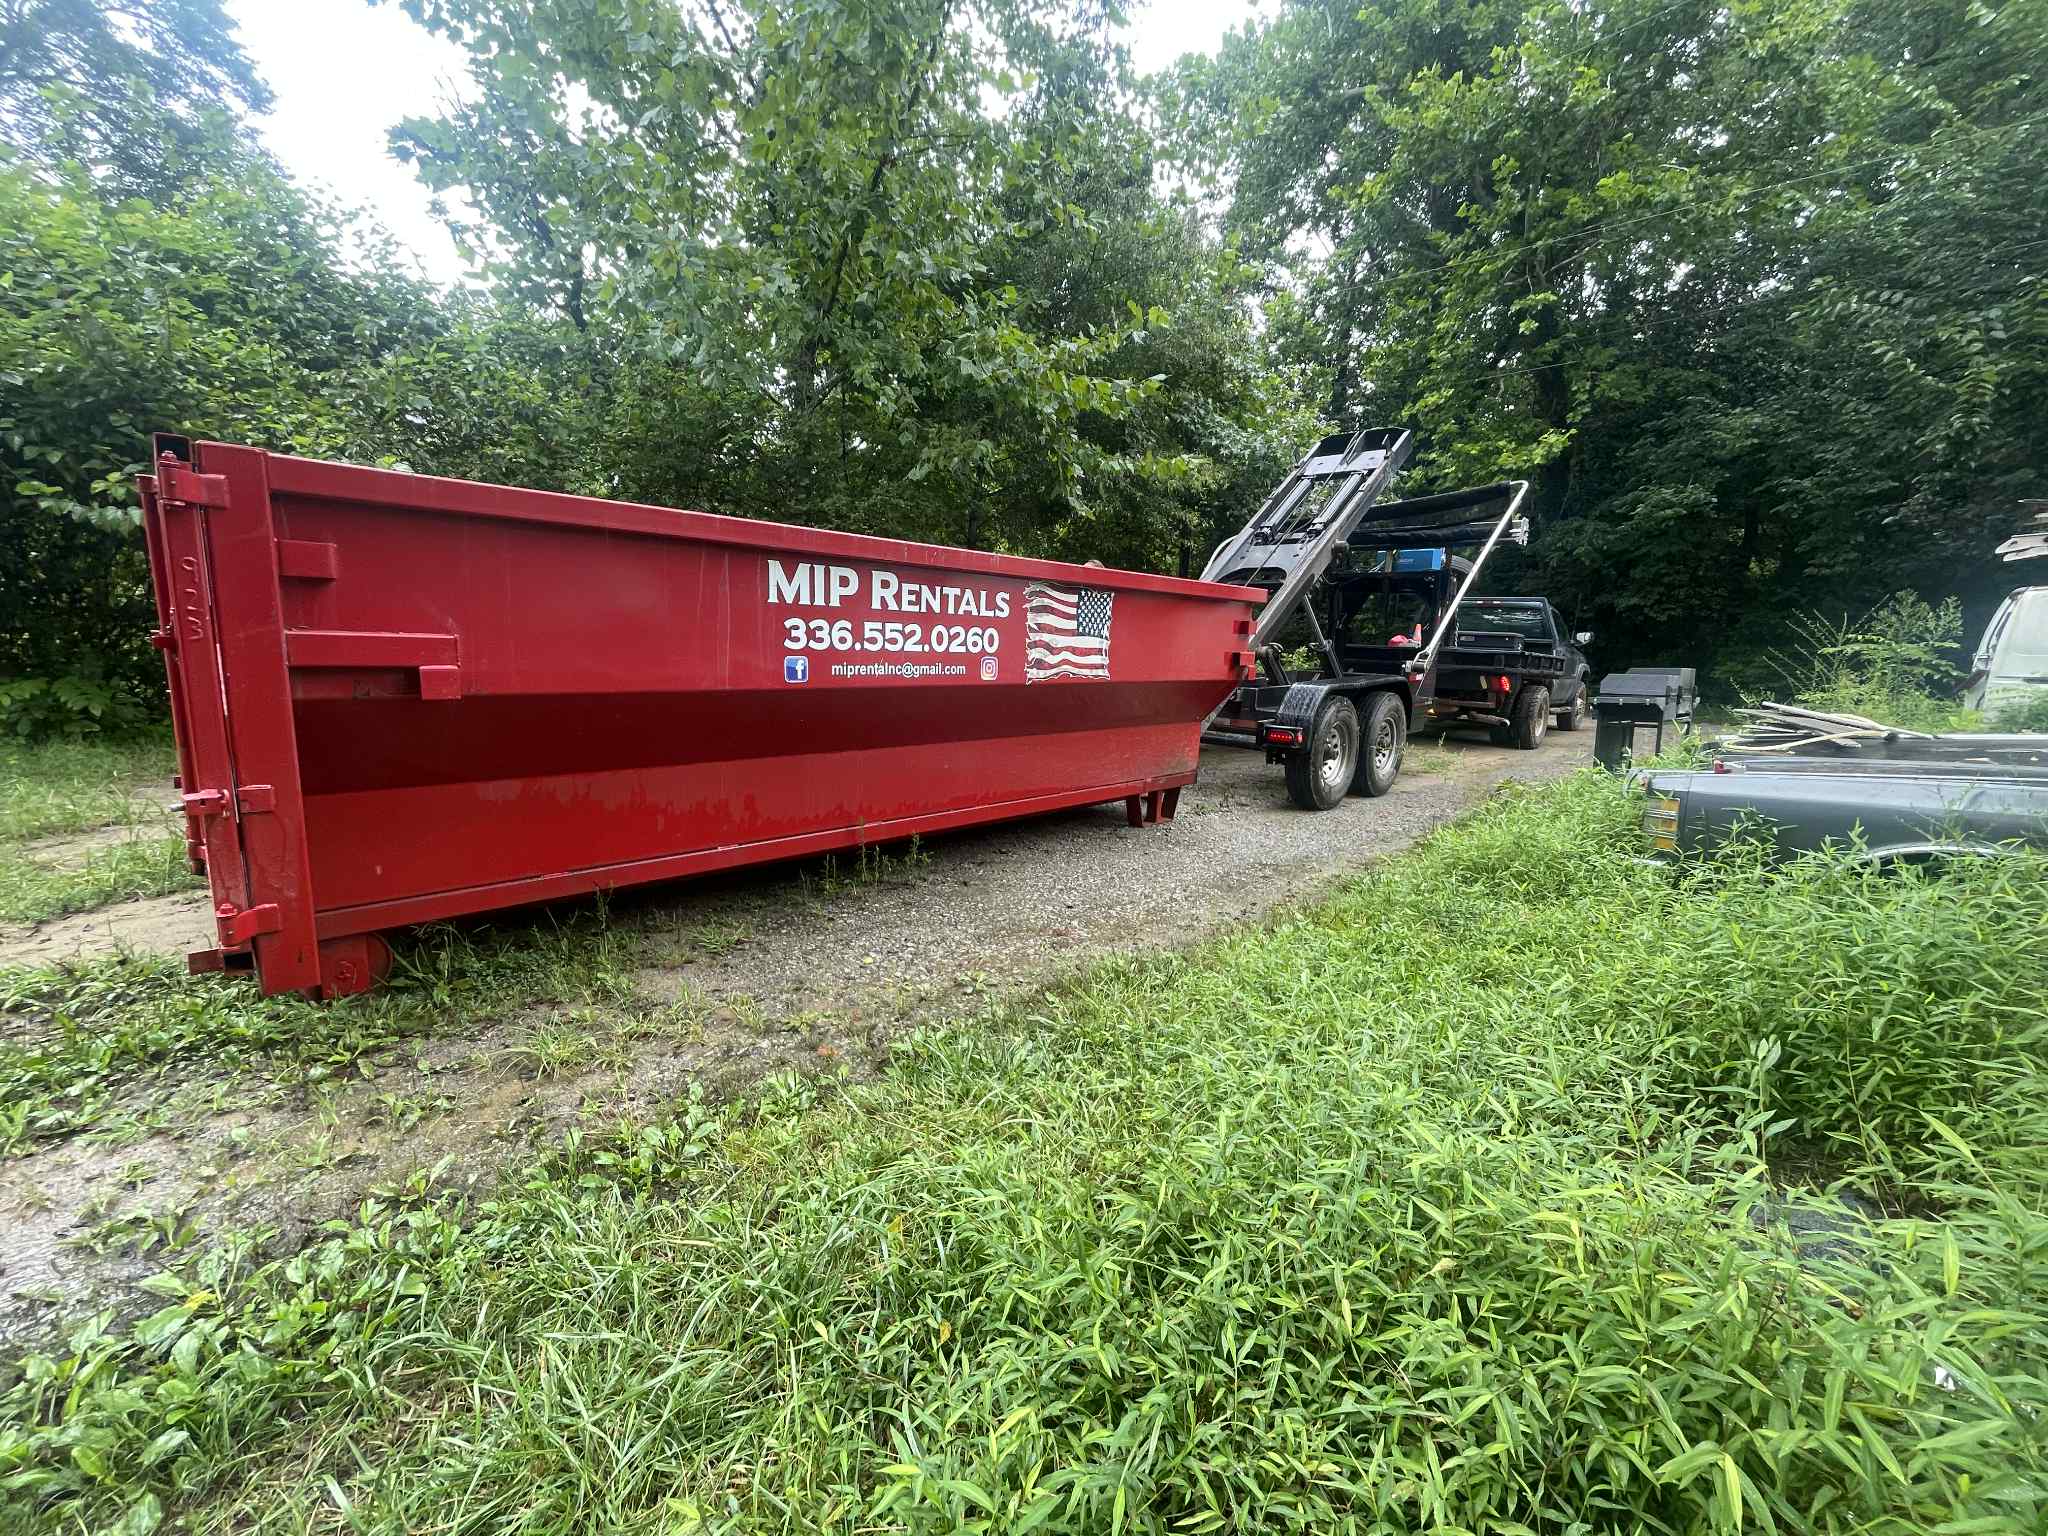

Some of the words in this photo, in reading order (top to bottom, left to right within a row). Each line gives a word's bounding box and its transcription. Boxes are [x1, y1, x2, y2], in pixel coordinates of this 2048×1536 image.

[767, 559, 859, 607] MIP
[871, 570, 1010, 618] RENTALS
[783, 617, 999, 653] 336.552.0260
[831, 661, 966, 678] miprentalnc@gmail.com
